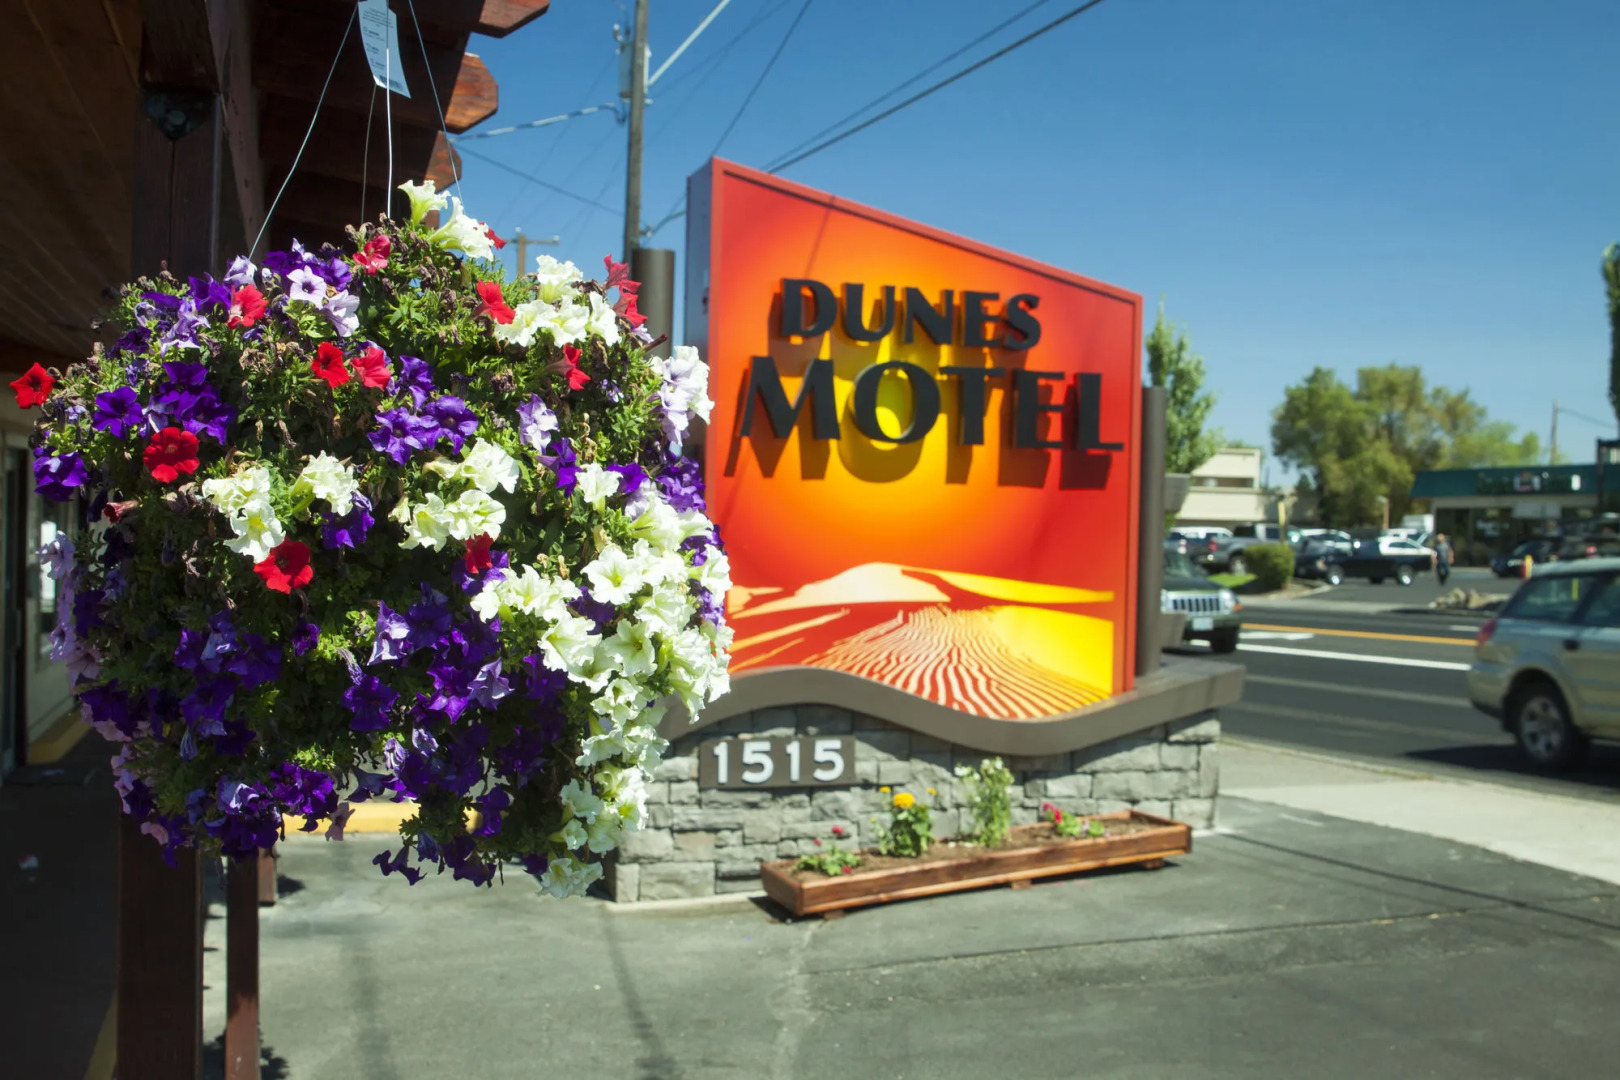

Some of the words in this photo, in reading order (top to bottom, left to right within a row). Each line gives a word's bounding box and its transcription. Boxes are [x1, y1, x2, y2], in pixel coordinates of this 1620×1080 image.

[780, 278, 1041, 350] DUNES
[739, 355, 1124, 451] MOTEL
[713, 739, 845, 783] 1515
